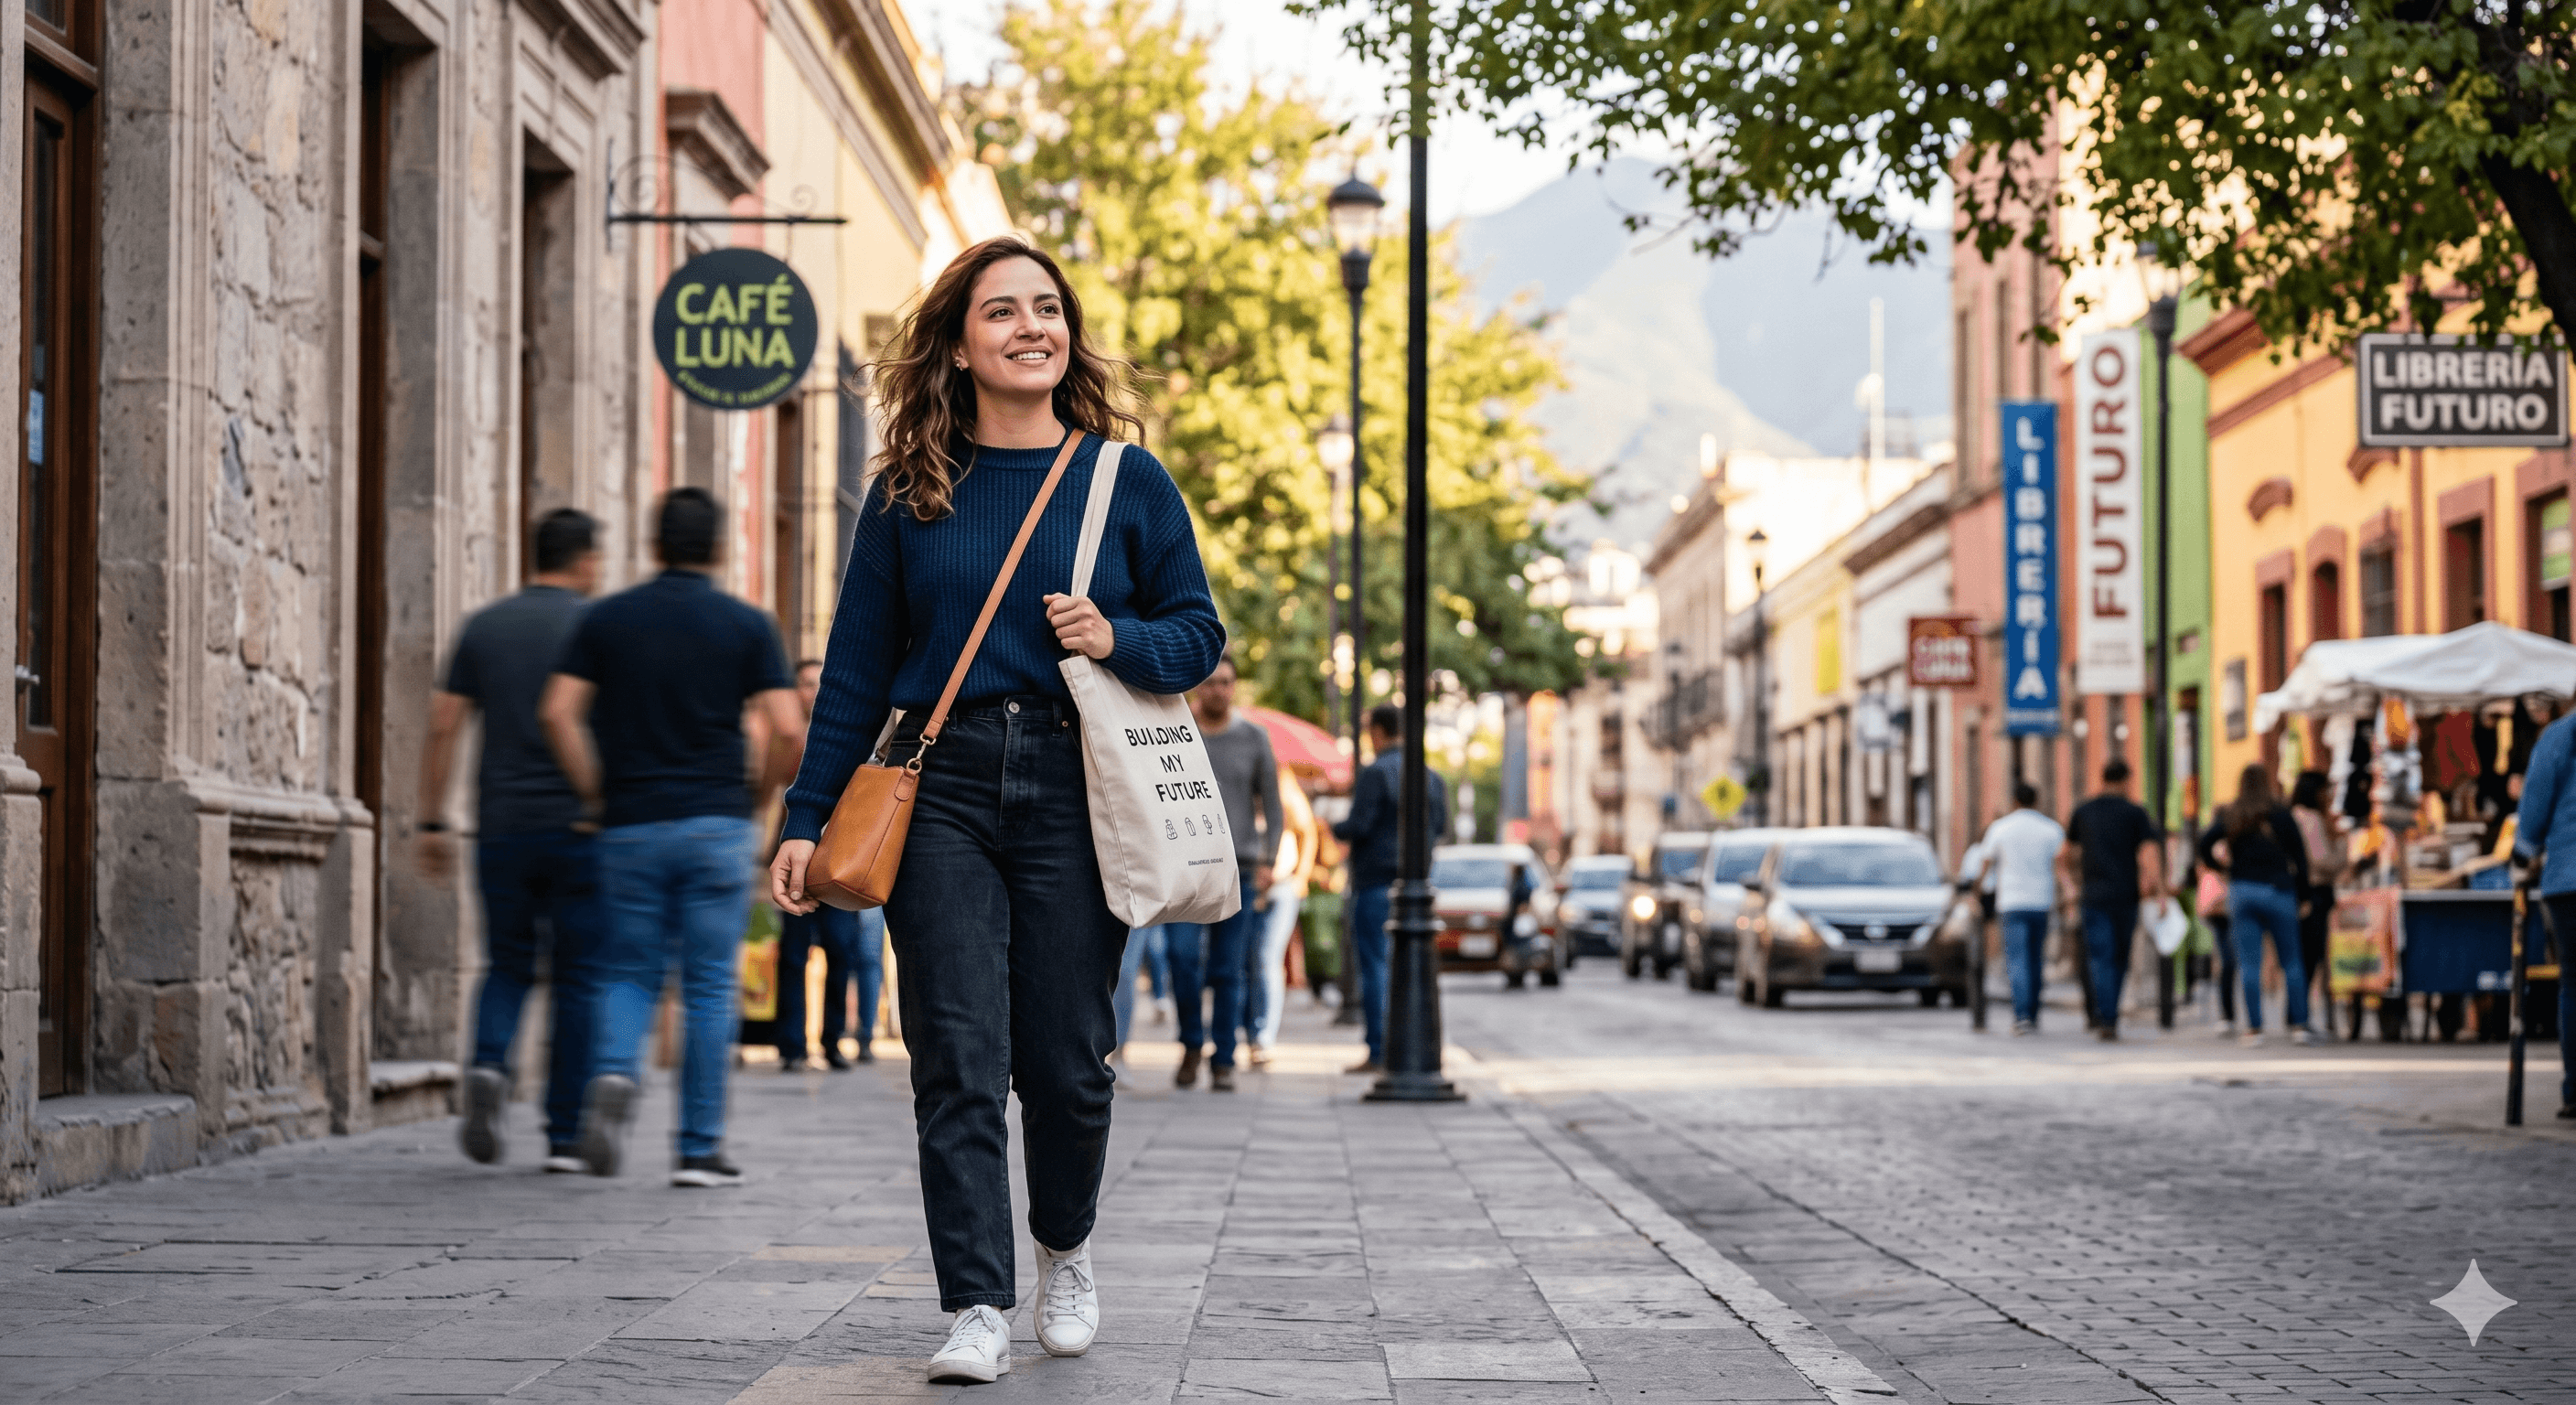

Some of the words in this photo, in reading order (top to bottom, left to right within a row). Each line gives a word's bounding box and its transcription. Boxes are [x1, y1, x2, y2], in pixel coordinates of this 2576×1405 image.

[675, 273, 794, 326] CAFÉ
[674, 327, 796, 368] LUNA
[2379, 392, 2549, 431] FUTURO
[2092, 345, 2127, 619] FUTURO
[2014, 415, 2047, 701] LIBRERIA
[1124, 724, 1193, 746] BUILDING
[1159, 754, 1185, 773] MY
[1155, 780, 1212, 802] FUTURE
